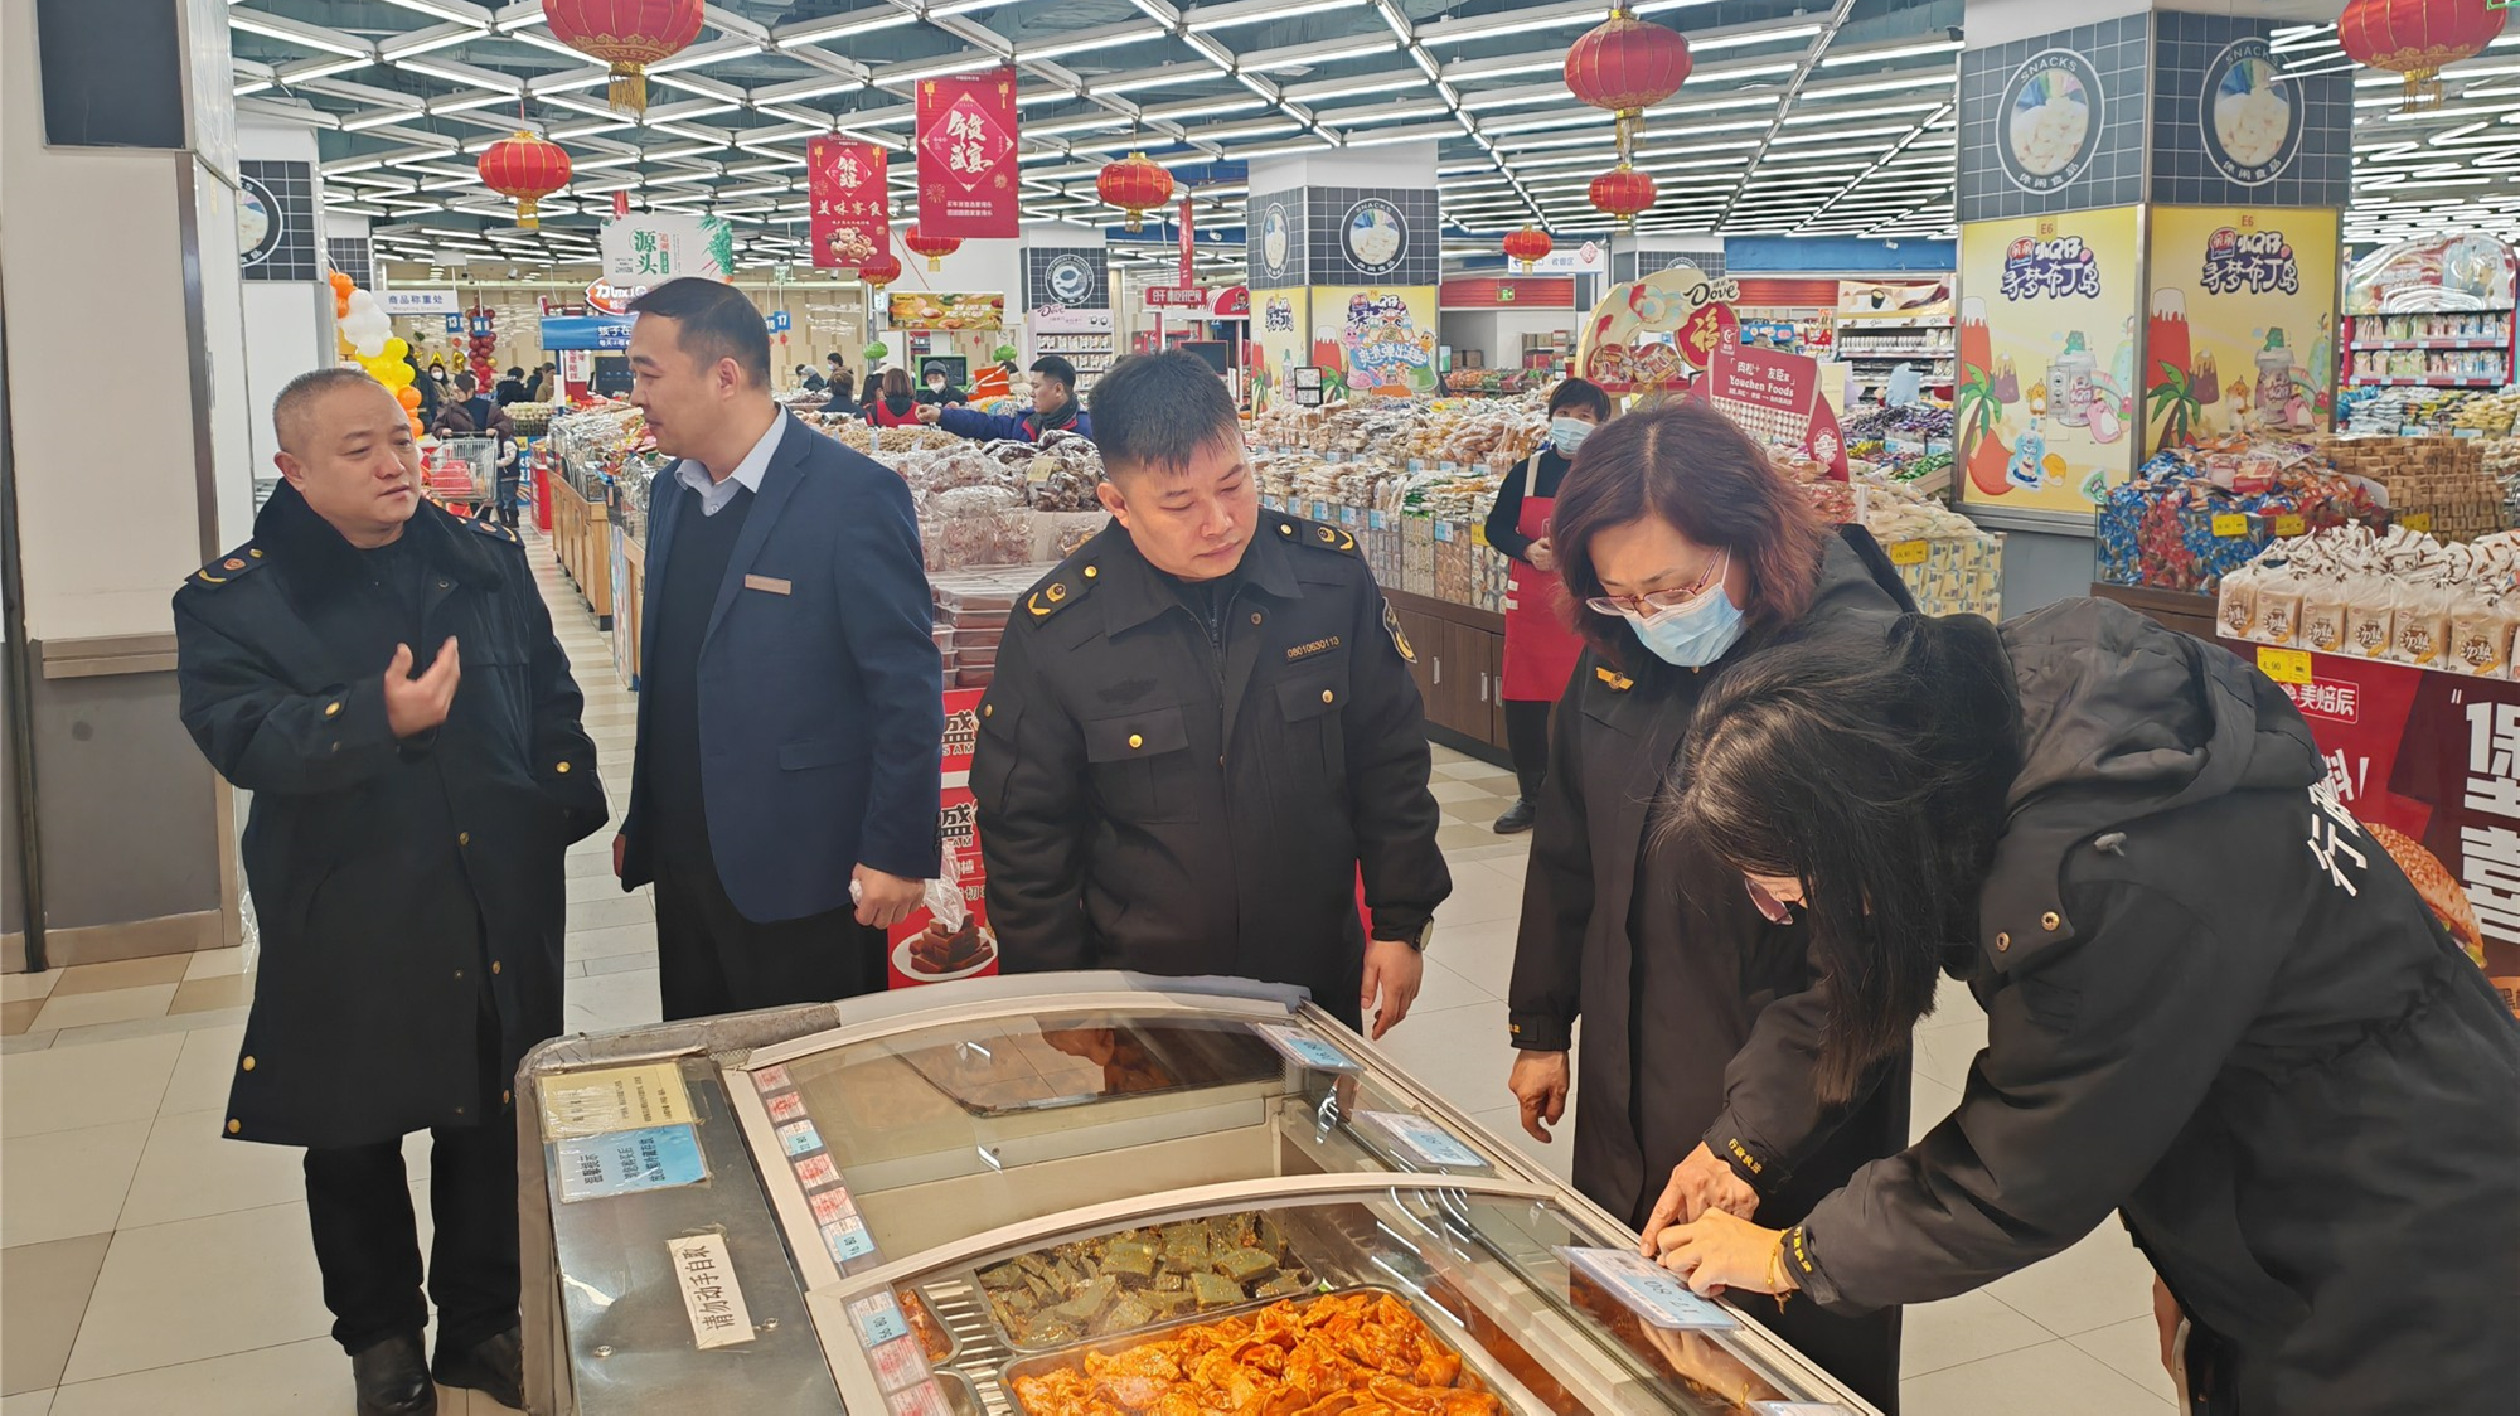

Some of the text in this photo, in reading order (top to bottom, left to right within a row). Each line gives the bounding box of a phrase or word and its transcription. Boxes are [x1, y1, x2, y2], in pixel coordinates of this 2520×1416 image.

[2020, 57, 2077, 83] SNACKS
[2040, 223, 2053, 234] E6
[2242, 214, 2254, 227] E6
[634, 231, 658, 275] 源头
[1683, 284, 1737, 305] Dove
[1690, 307, 1720, 353] 福
[1768, 383, 1794, 397] Foods
